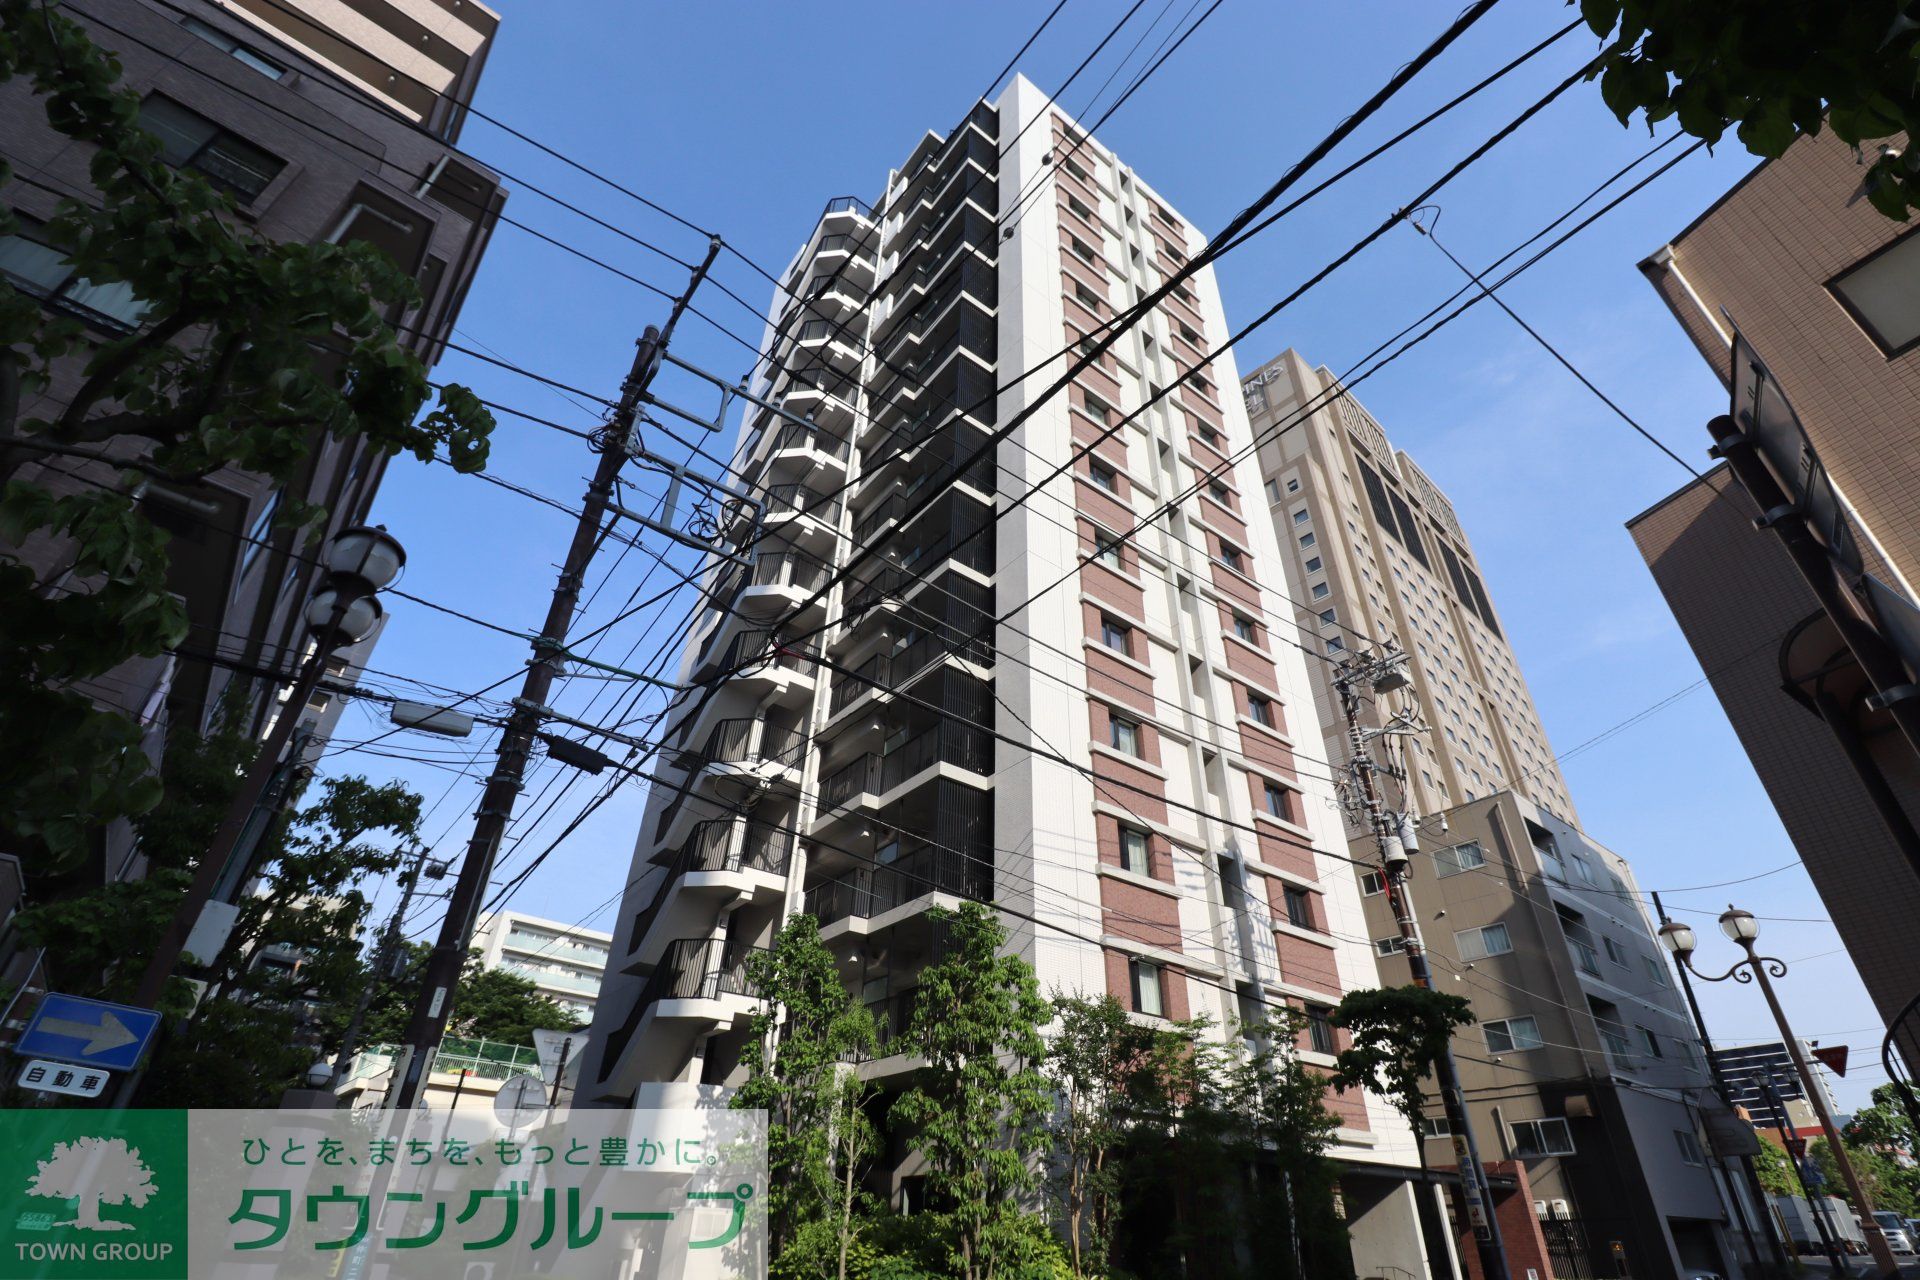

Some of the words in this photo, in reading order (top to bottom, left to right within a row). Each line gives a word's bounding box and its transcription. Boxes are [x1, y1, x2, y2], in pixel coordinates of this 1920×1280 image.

[1241, 367, 1283, 395] INES
[26, 1066, 101, 1091] 自動車
